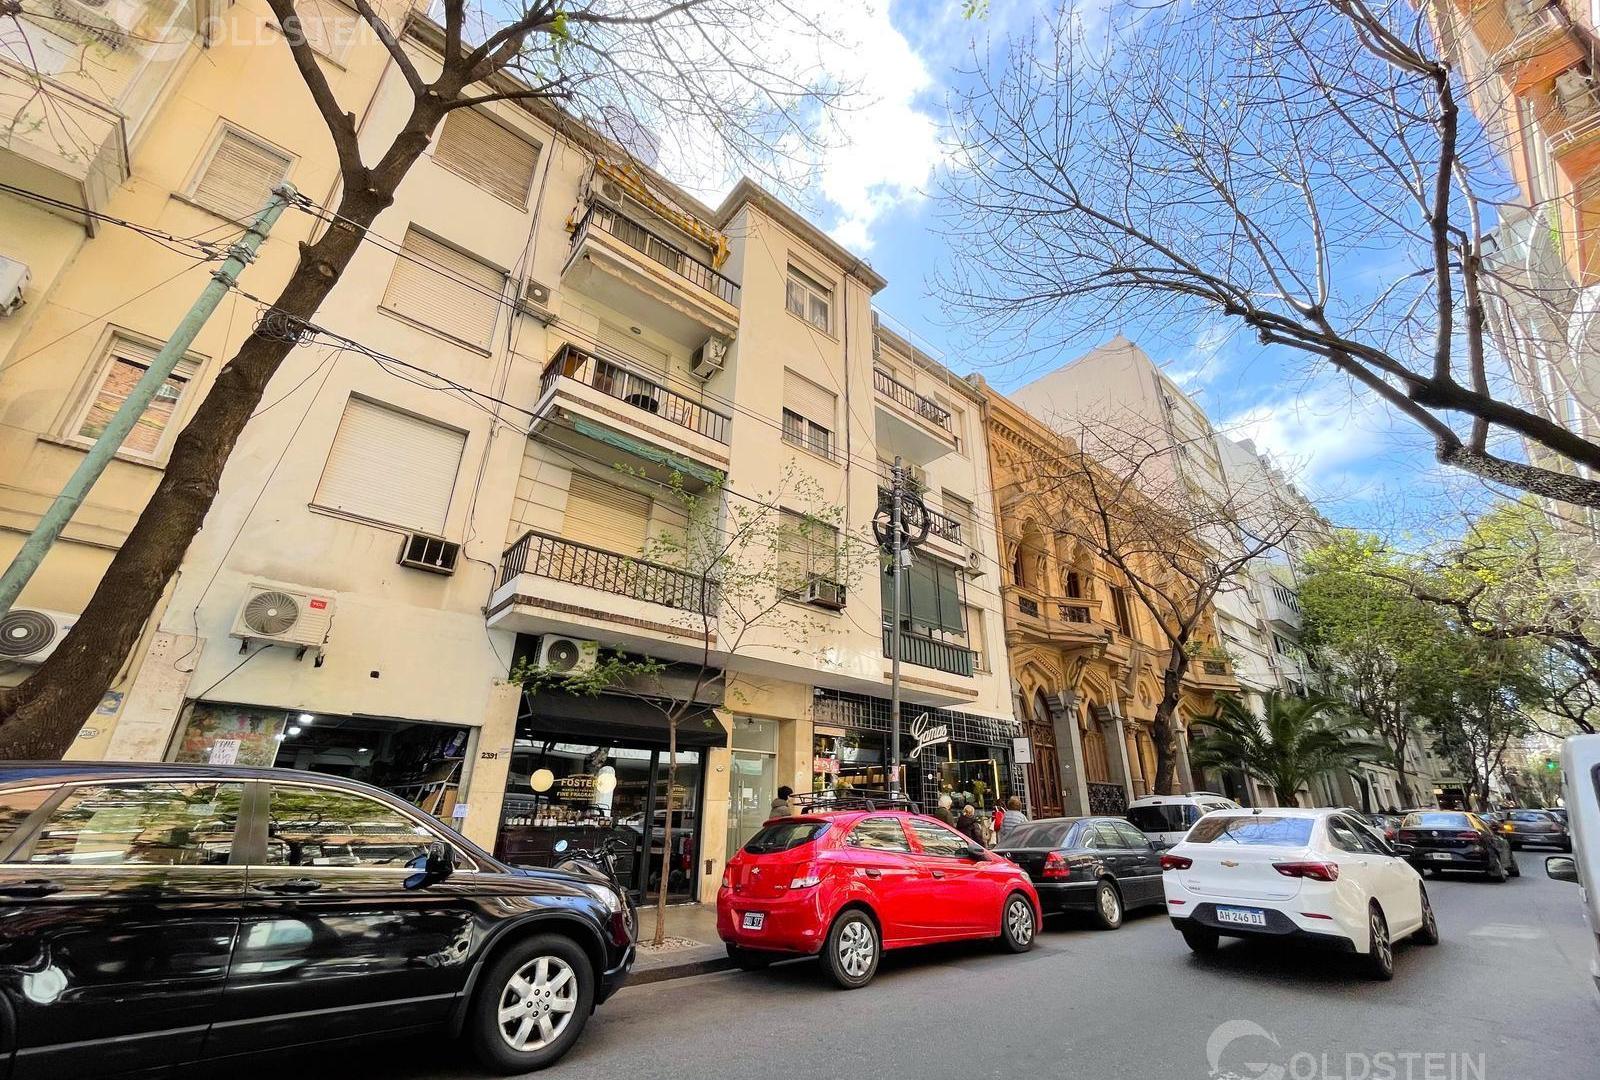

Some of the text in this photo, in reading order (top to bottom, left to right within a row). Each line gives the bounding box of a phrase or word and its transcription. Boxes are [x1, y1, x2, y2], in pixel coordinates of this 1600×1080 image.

[909, 711, 948, 758] Gamas
[481, 752, 498, 760] 2391
[1219, 910, 1231, 921] AH
[1232, 912, 1249, 922] 246
